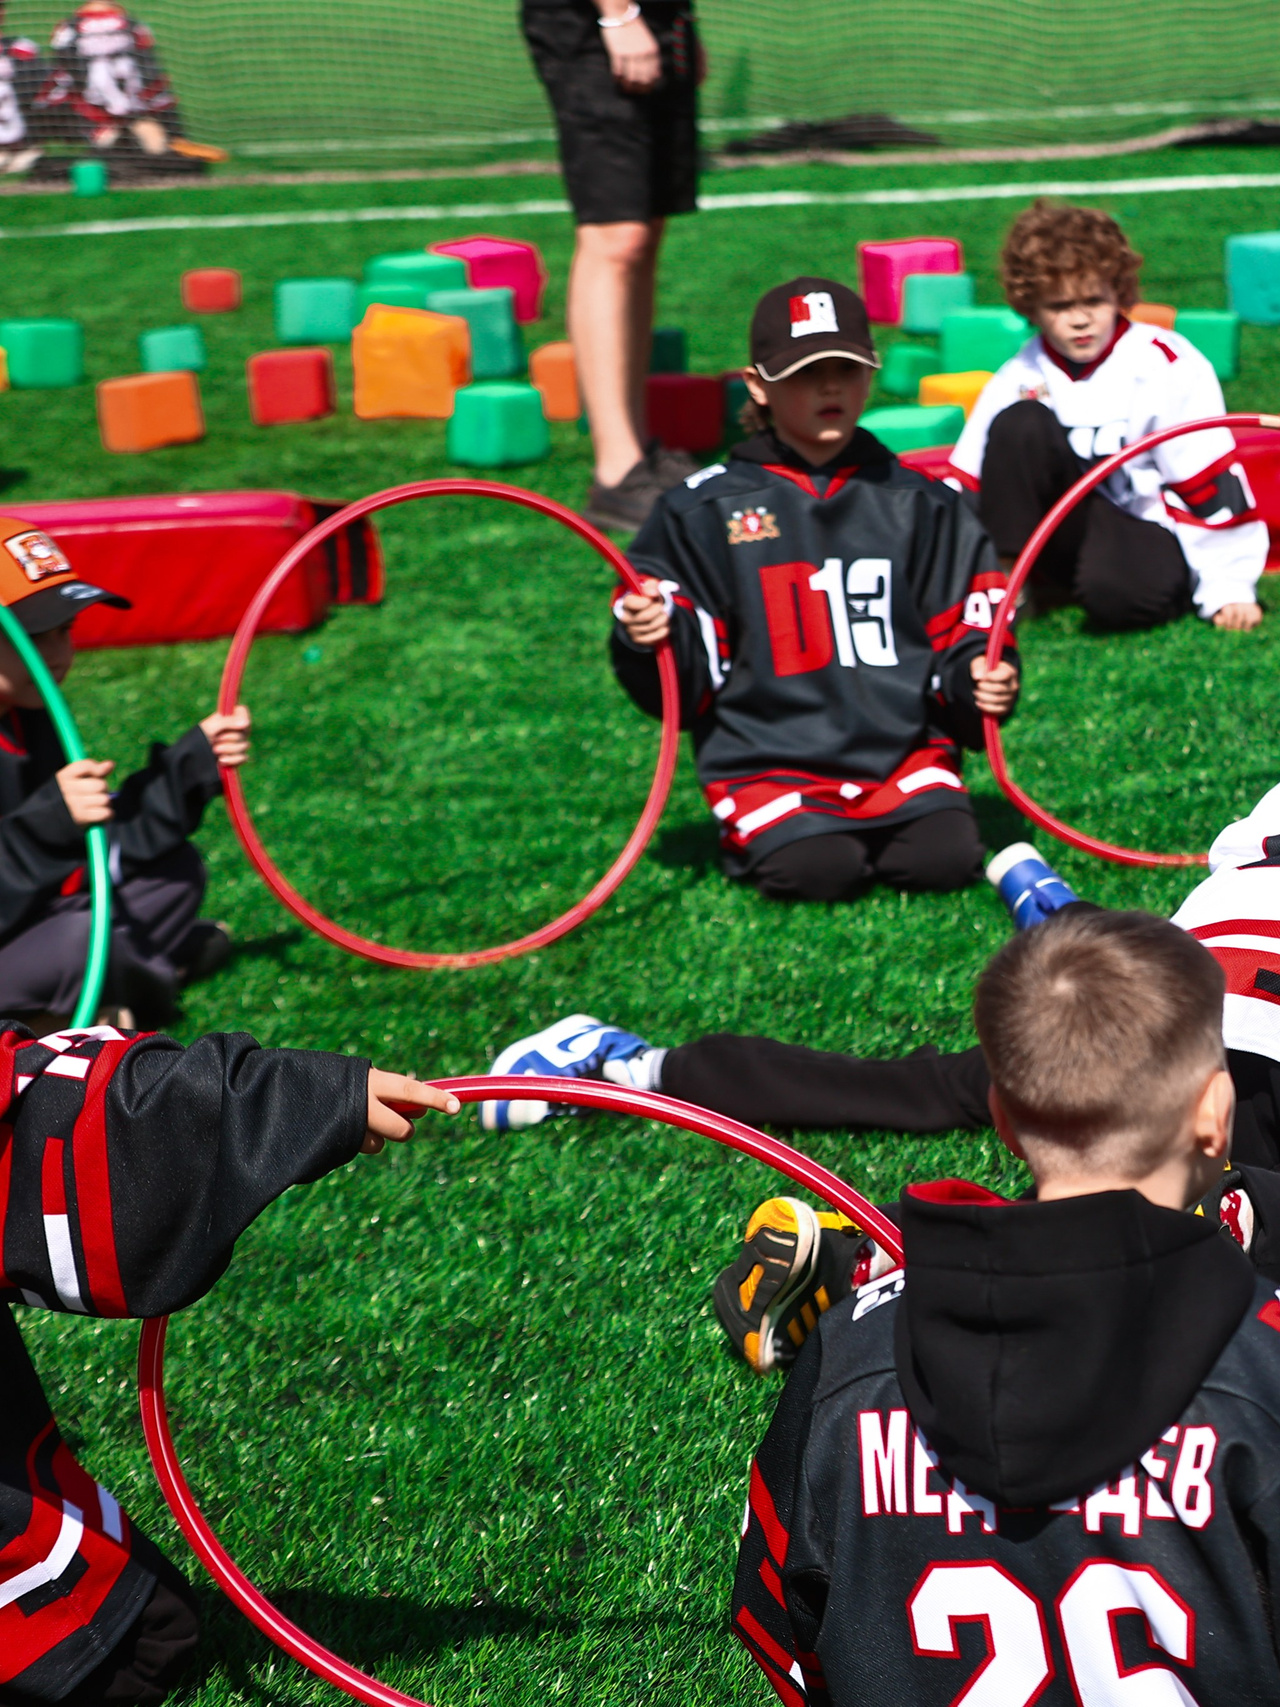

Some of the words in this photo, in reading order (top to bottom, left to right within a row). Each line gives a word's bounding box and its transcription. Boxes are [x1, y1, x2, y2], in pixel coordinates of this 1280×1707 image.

[758, 557, 900, 678] D13
[857, 1408, 1218, 1538] МЕДДЕВ
[905, 1557, 1197, 1707] 26
